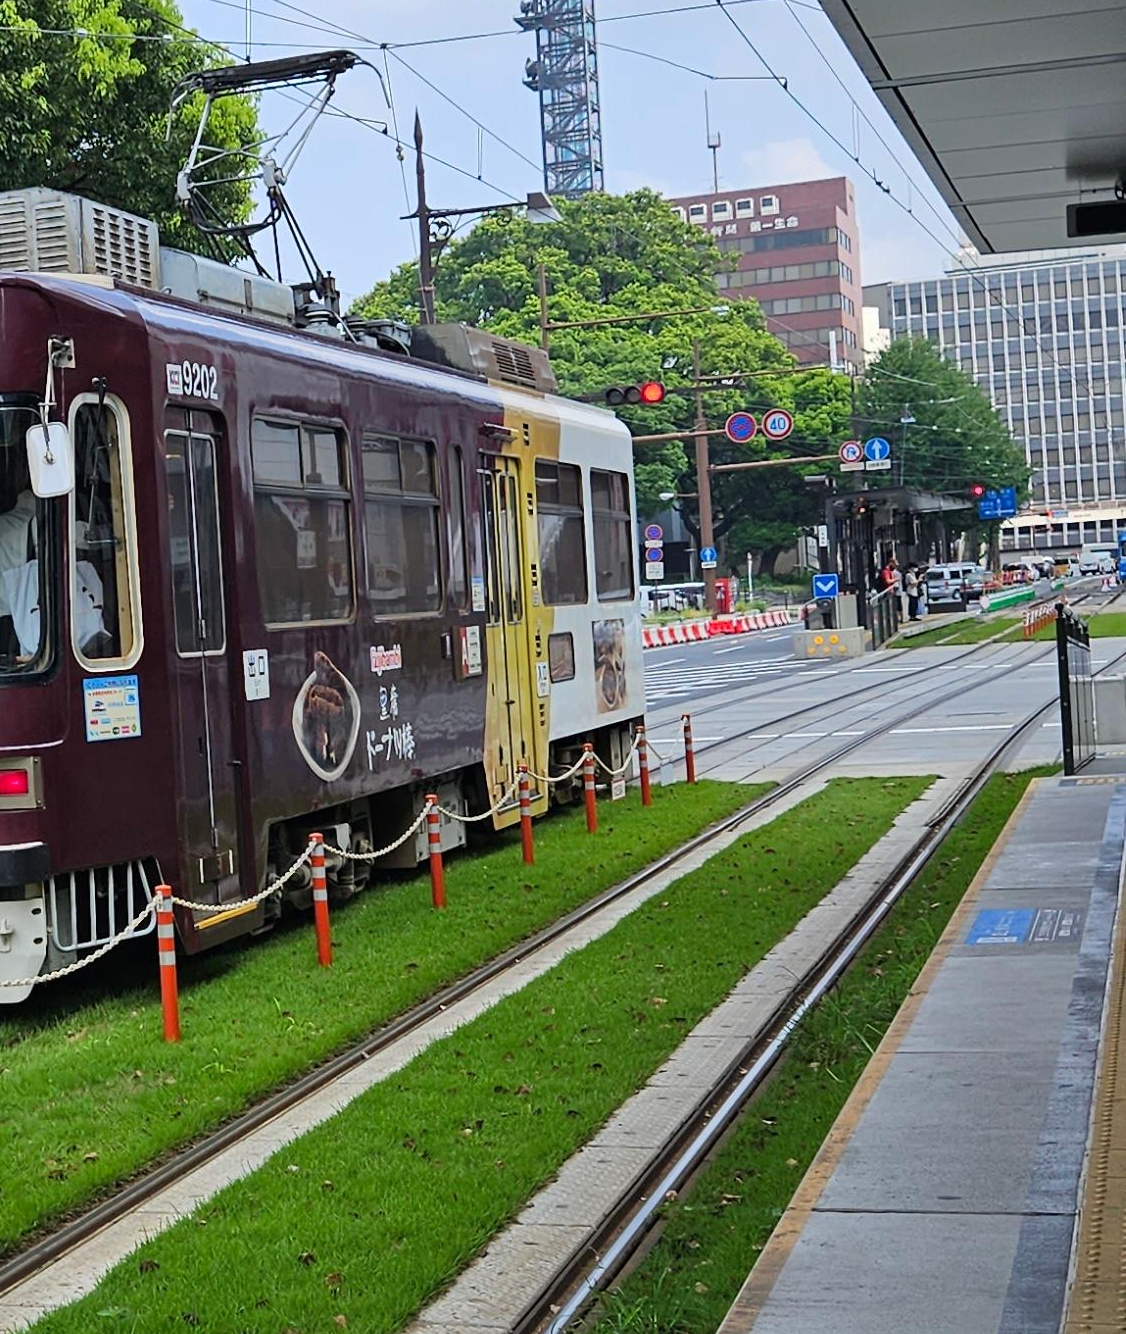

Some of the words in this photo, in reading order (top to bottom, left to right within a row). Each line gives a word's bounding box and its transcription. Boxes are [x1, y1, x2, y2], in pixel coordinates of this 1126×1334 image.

[183, 360, 218, 400] 9202
[770, 417, 786, 430] 40
[247, 654, 265, 677] 出口
